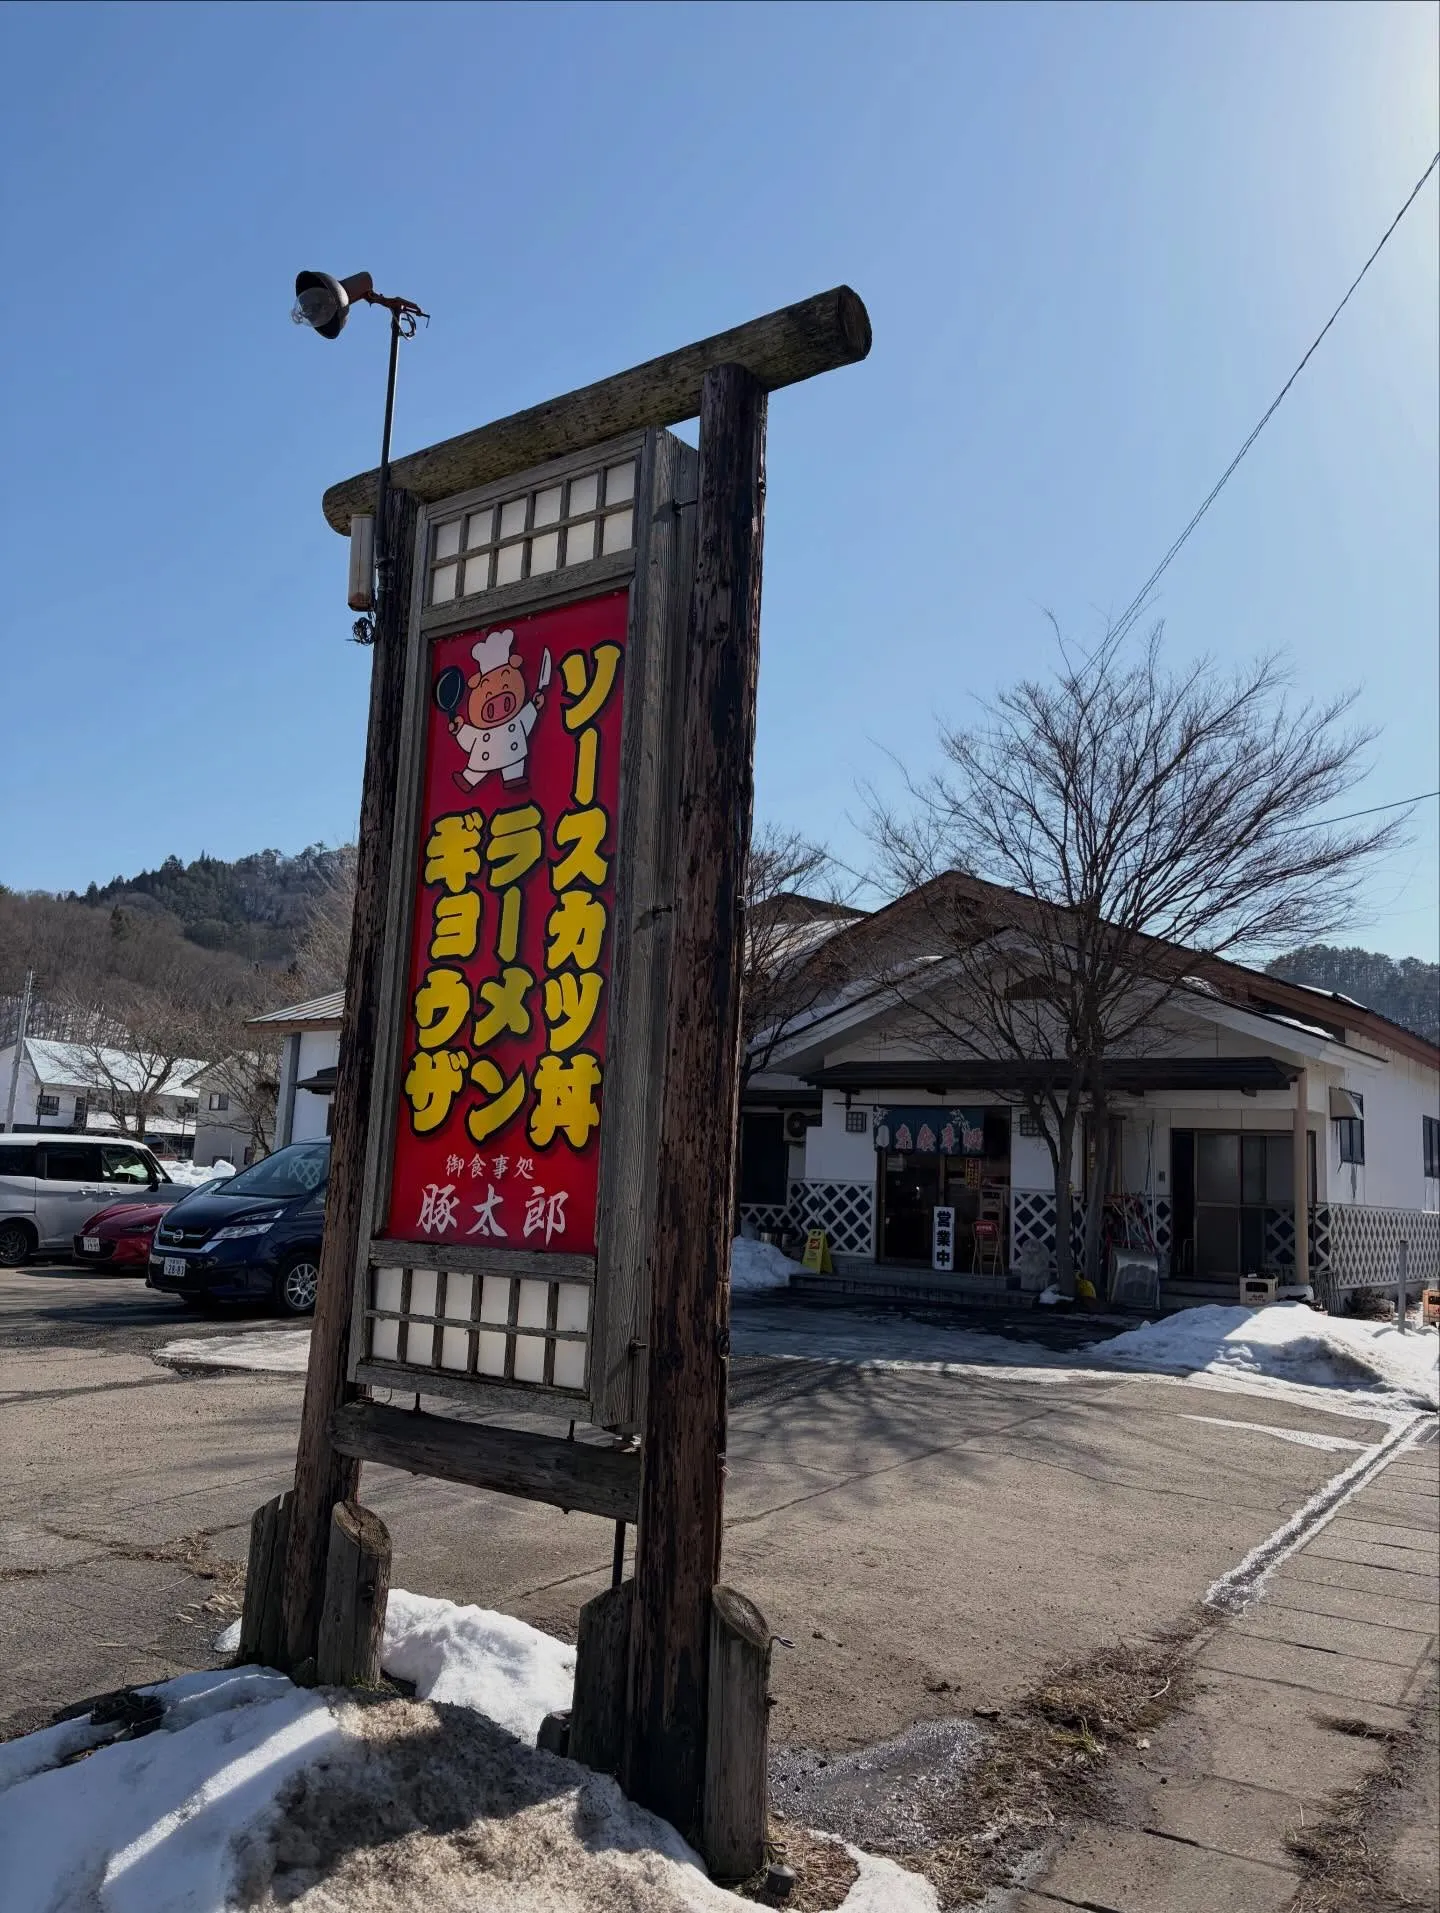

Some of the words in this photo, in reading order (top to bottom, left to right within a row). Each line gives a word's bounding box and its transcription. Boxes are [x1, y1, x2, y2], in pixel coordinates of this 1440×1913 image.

[405, 810, 483, 1133] ギョウザ
[470, 805, 543, 1143] ラーメン
[530, 642, 622, 1148] ソースカツ丼
[416, 1183, 569, 1247] 豚太郎
[446, 1153, 535, 1179] 御食事処
[936, 1210, 952, 1266] 営業中
